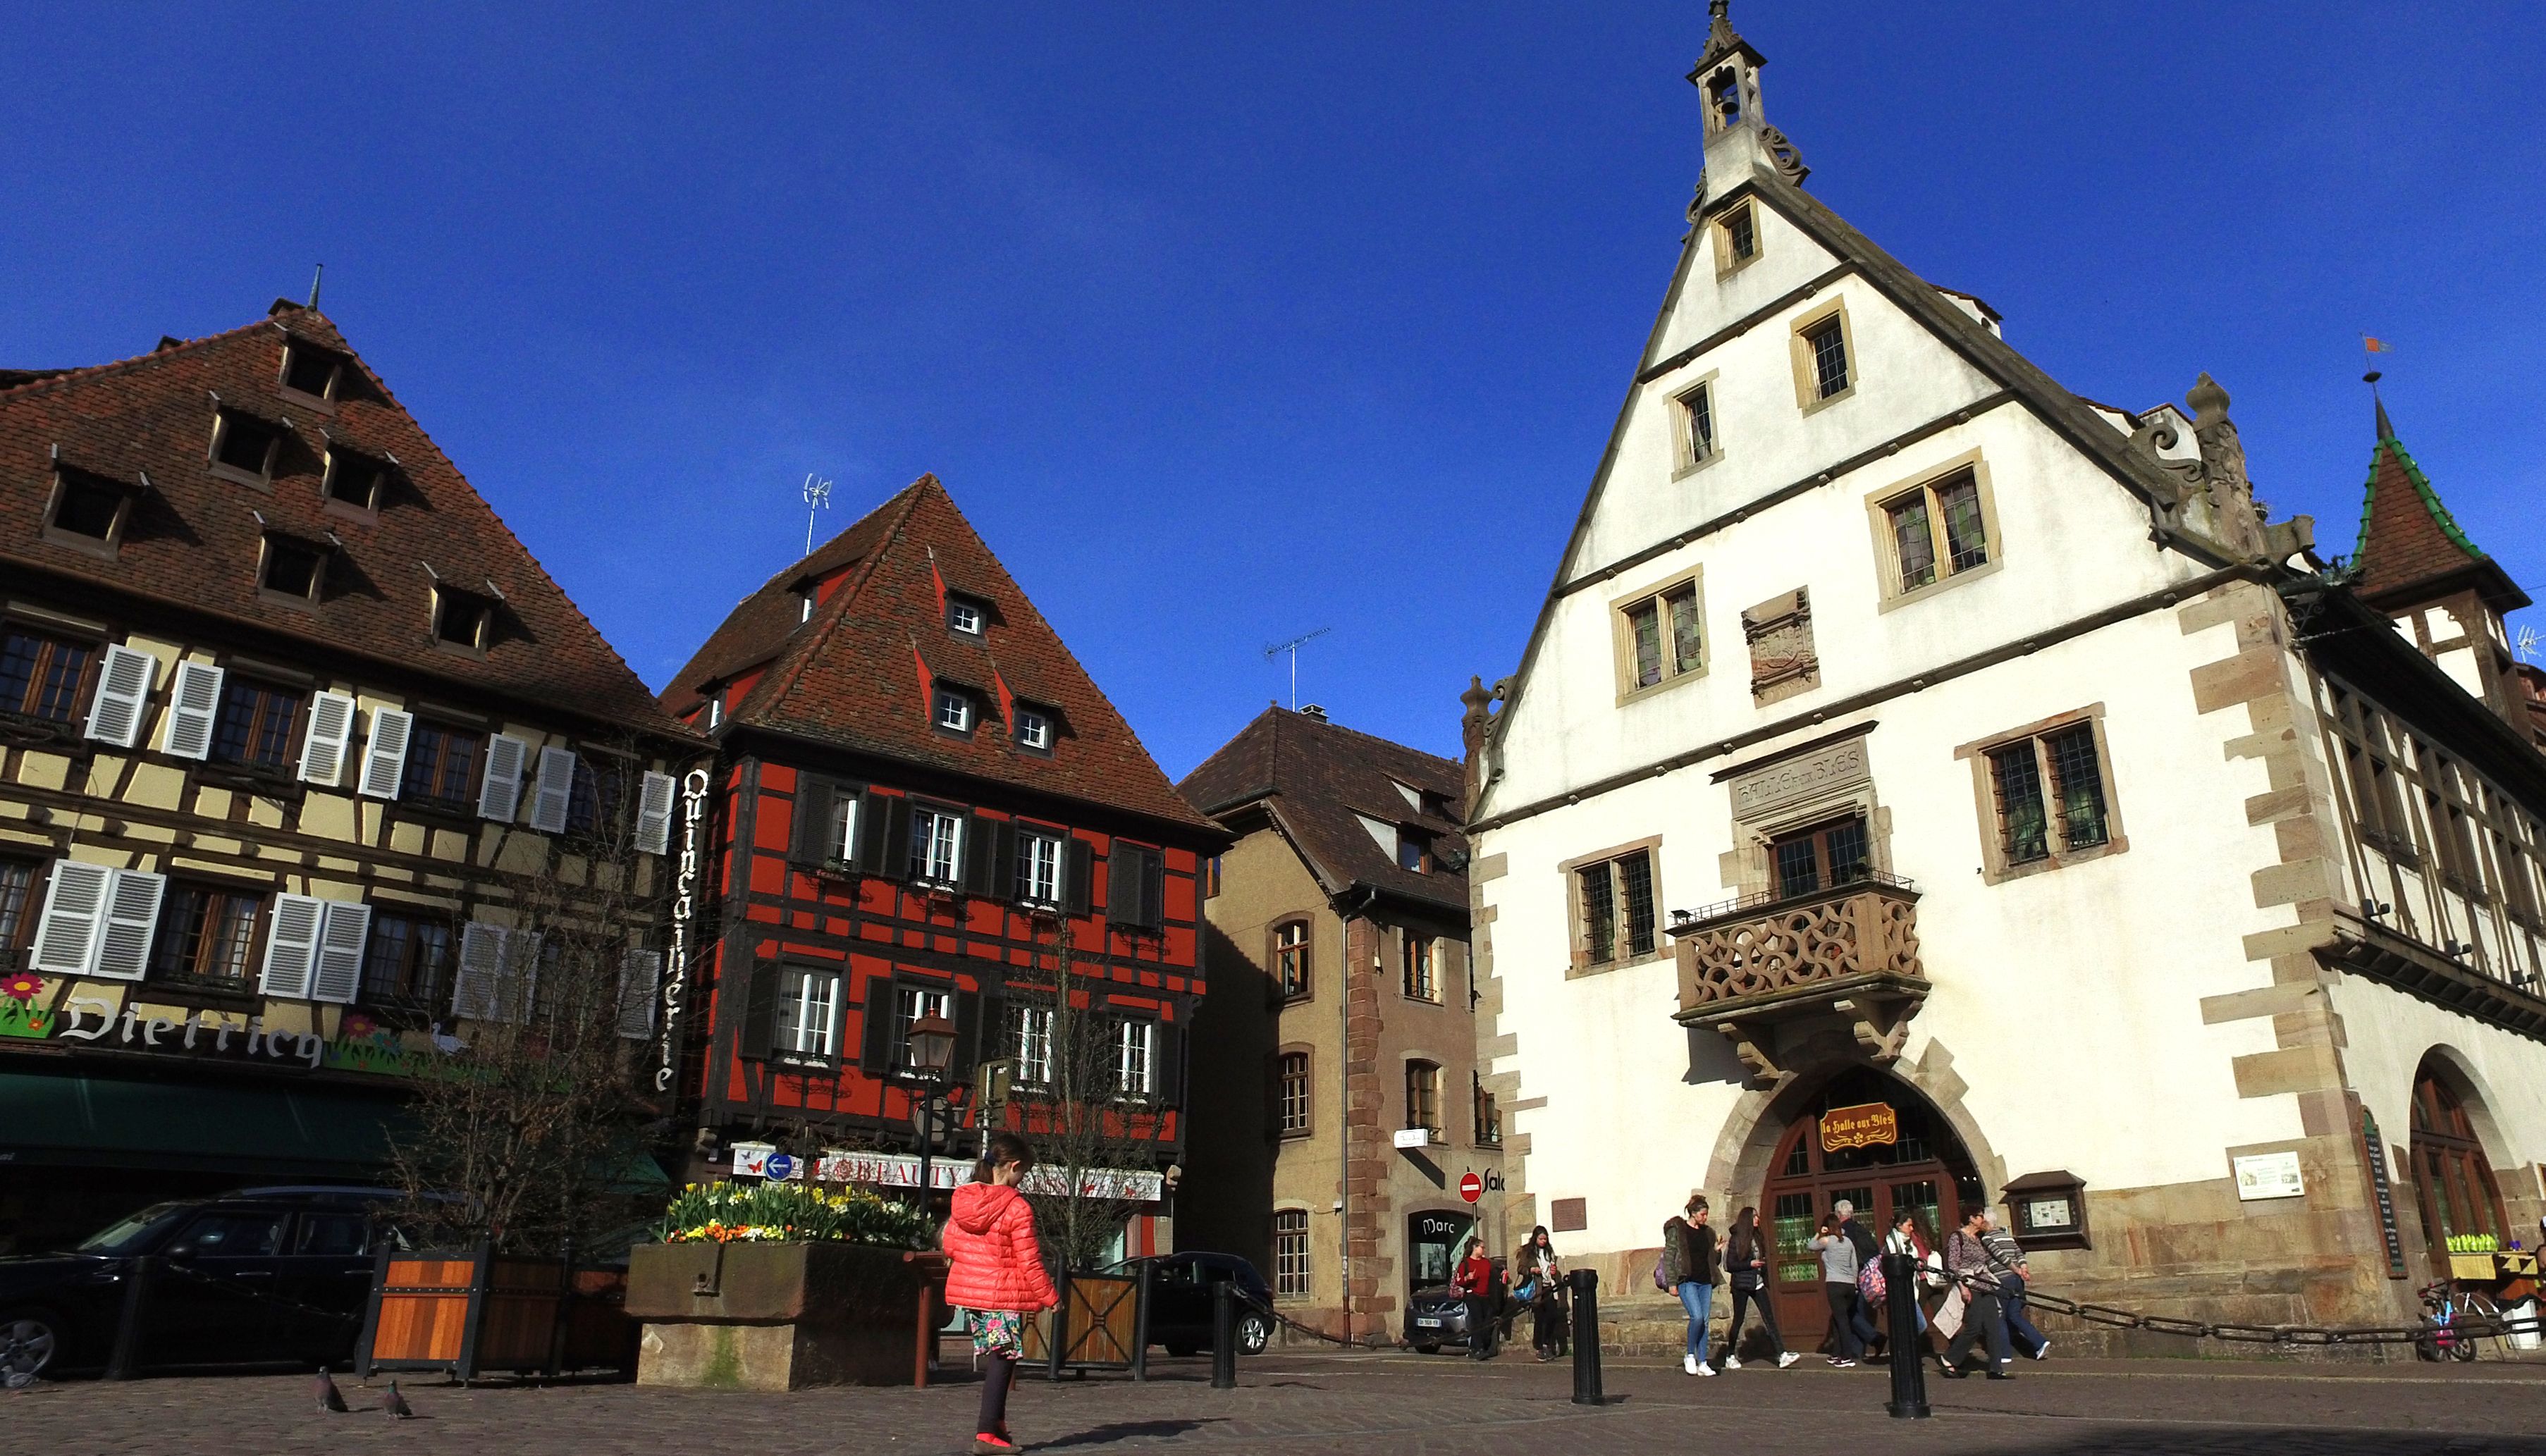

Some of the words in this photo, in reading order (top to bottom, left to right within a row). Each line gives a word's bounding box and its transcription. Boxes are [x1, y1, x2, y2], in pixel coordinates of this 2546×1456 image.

[656, 768, 708, 1092] Quincaillerie
[1833, 1118, 1855, 1134] Halle
[1857, 1118, 1871, 1129] aux
[856, 1159, 962, 1187] BEAUTY
[1422, 1218, 1455, 1235] Marc
